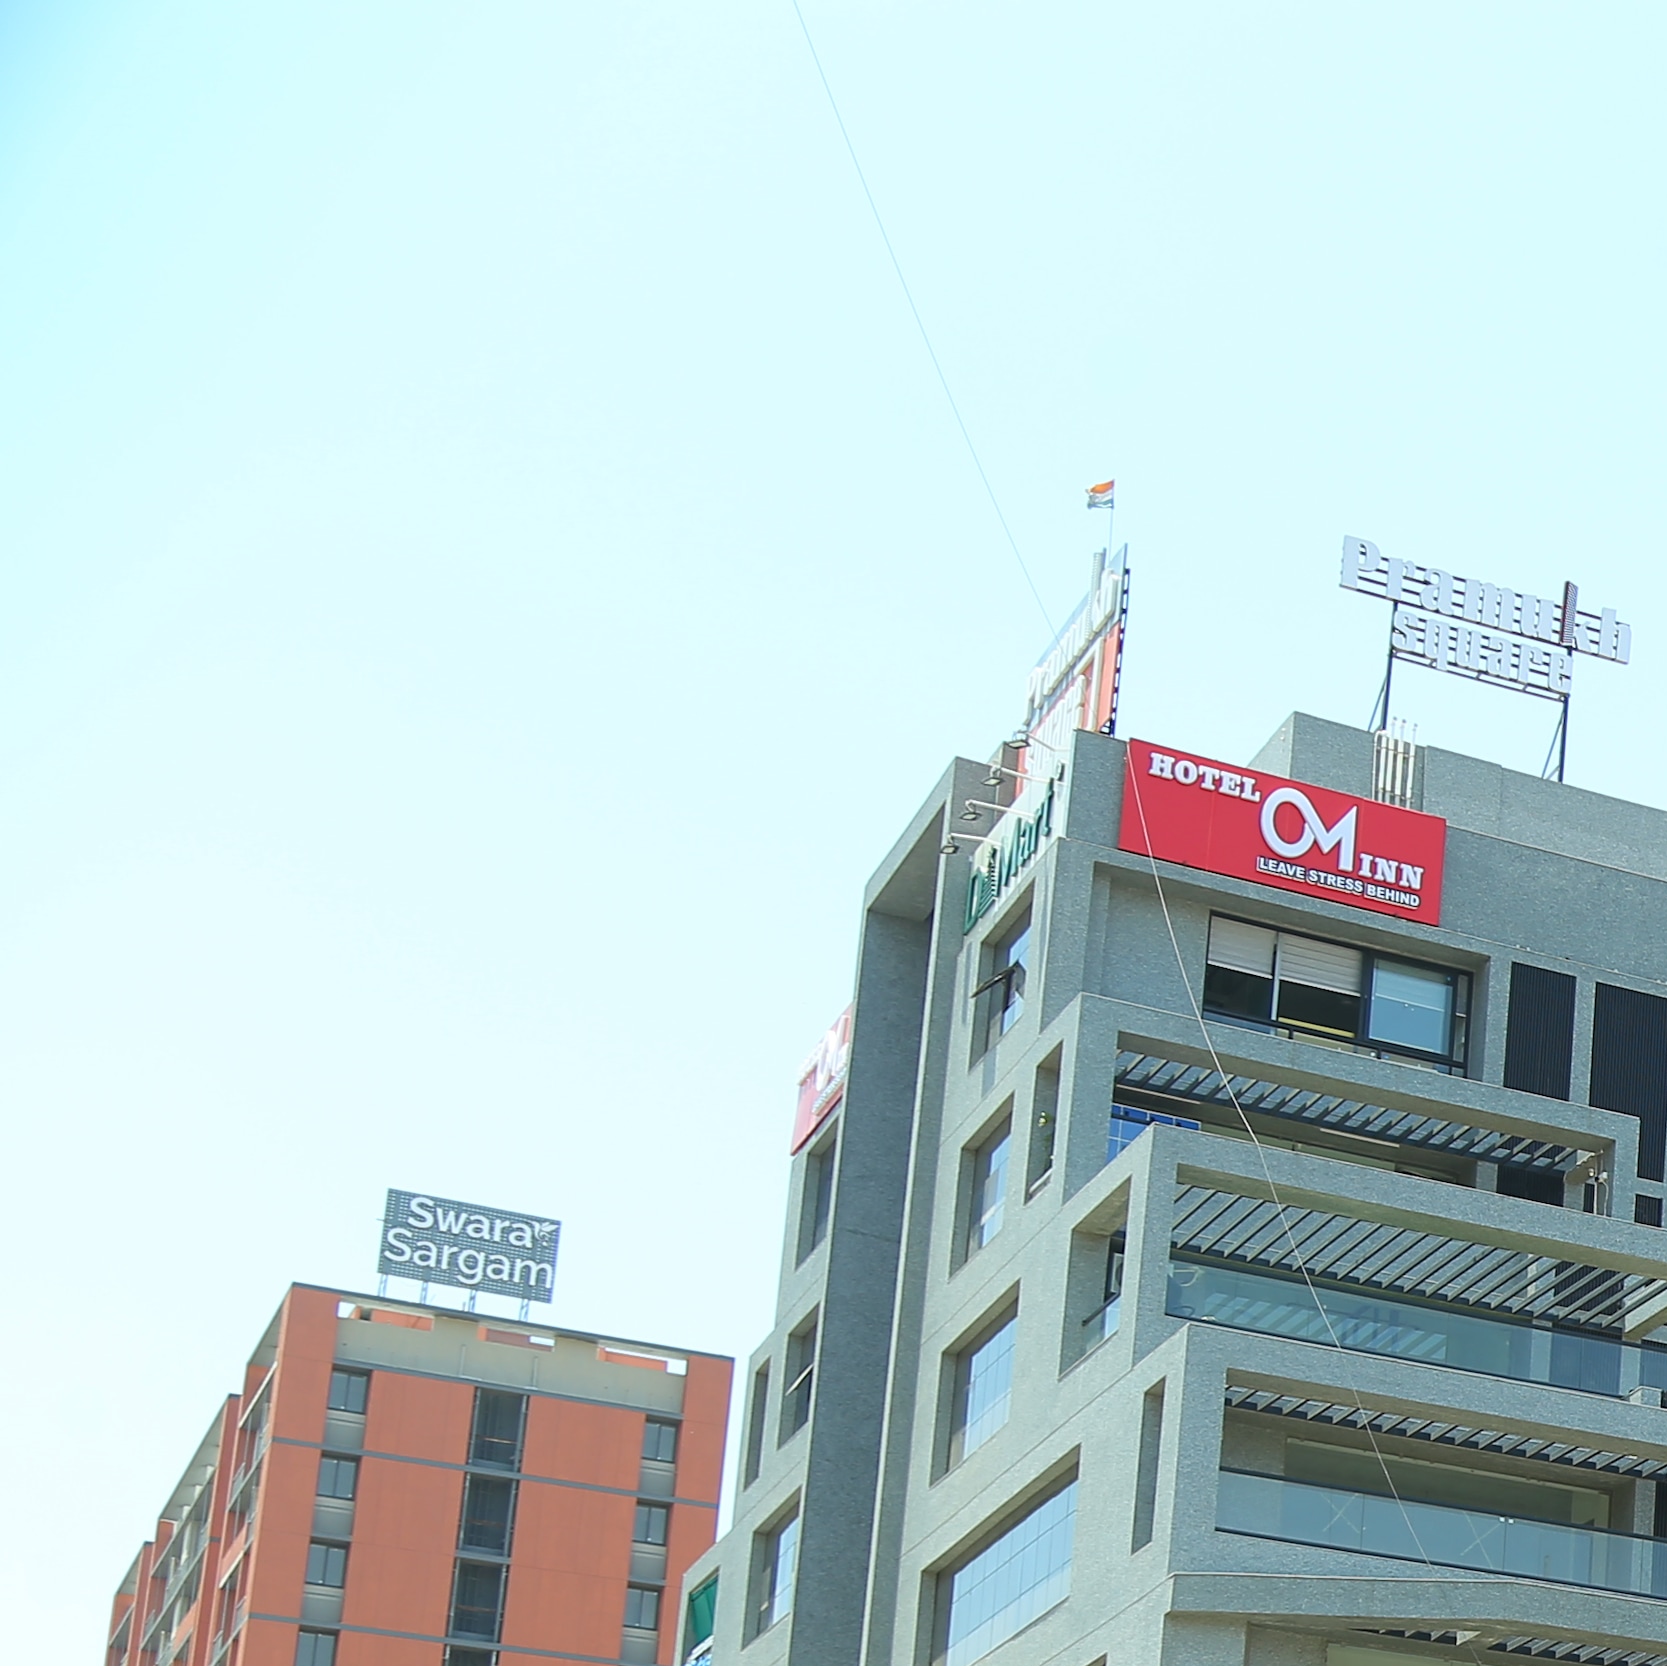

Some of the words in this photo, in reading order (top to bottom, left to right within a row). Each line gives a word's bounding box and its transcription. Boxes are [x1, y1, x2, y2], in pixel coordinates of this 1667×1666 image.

[1339, 534, 1631, 664] Pramukh
[1392, 606, 1574, 695] square
[1149, 752, 1260, 802] HOTEL
[1260, 787, 1358, 871] OM
[1257, 856, 1305, 880] LEAVE
[1309, 870, 1363, 895] STRESS
[1365, 884, 1420, 909] BEHIND
[1359, 853, 1424, 890] INN
[408, 1197, 533, 1248] Swara
[384, 1228, 551, 1288] Sargam
